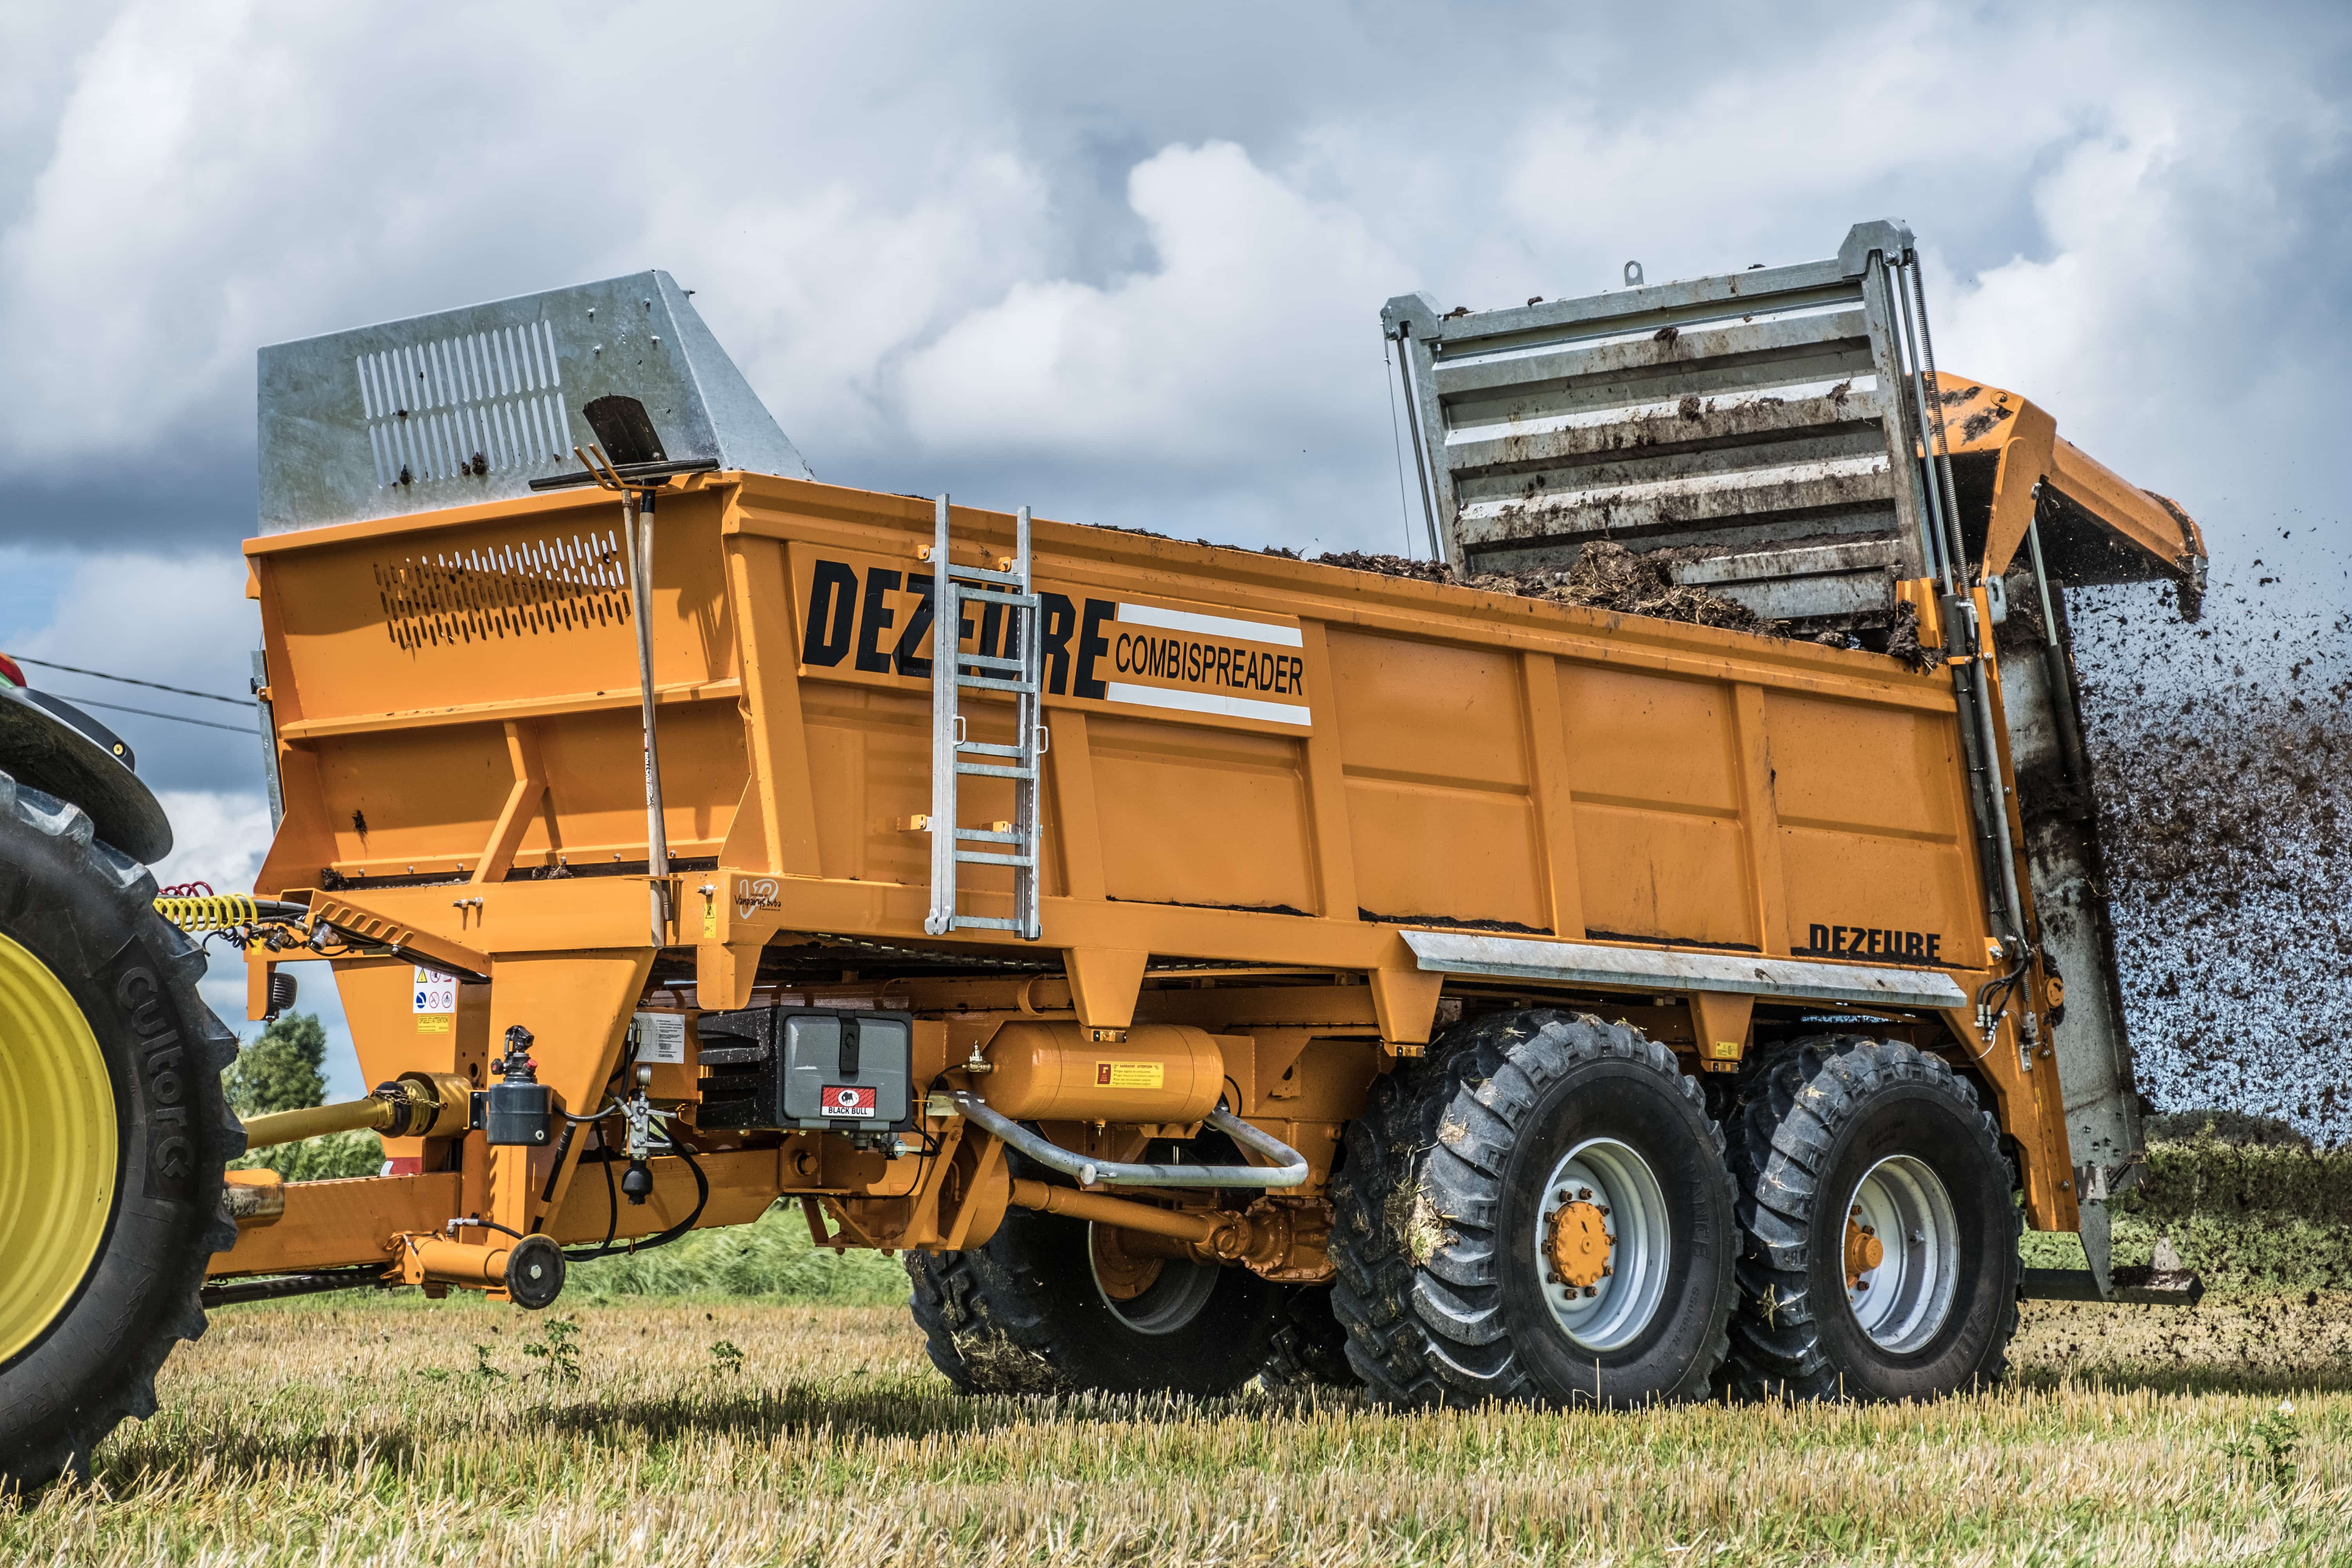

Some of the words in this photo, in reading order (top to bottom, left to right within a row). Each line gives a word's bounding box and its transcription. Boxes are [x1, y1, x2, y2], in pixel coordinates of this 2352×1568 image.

[802, 559, 1116, 700] DEZEURE
[1116, 633, 1303, 696] COMBISPREADER
[734, 893, 766, 910] Vanparys
[767, 898, 781, 907] bvba
[1809, 923, 1941, 960] DEZEURE
[119, 967, 188, 1126] Cultor
